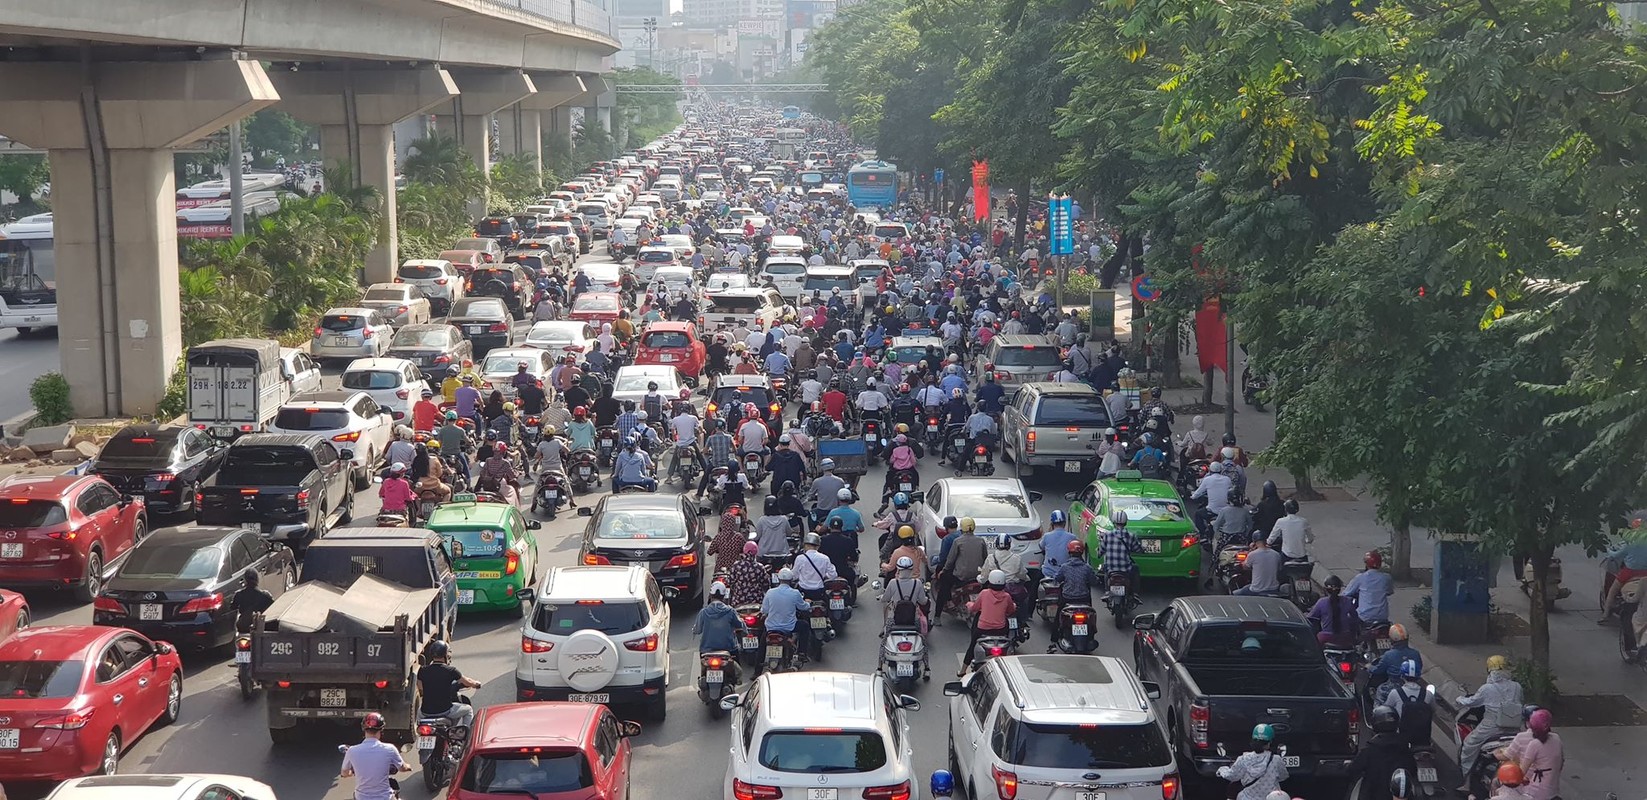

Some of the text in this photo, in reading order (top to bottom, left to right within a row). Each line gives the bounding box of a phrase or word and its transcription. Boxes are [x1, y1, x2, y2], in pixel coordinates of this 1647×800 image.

[270, 642, 381, 657] 29C 982 97
[321, 698, 346, 706] 982.97
[814, 789, 831, 799] 30F
